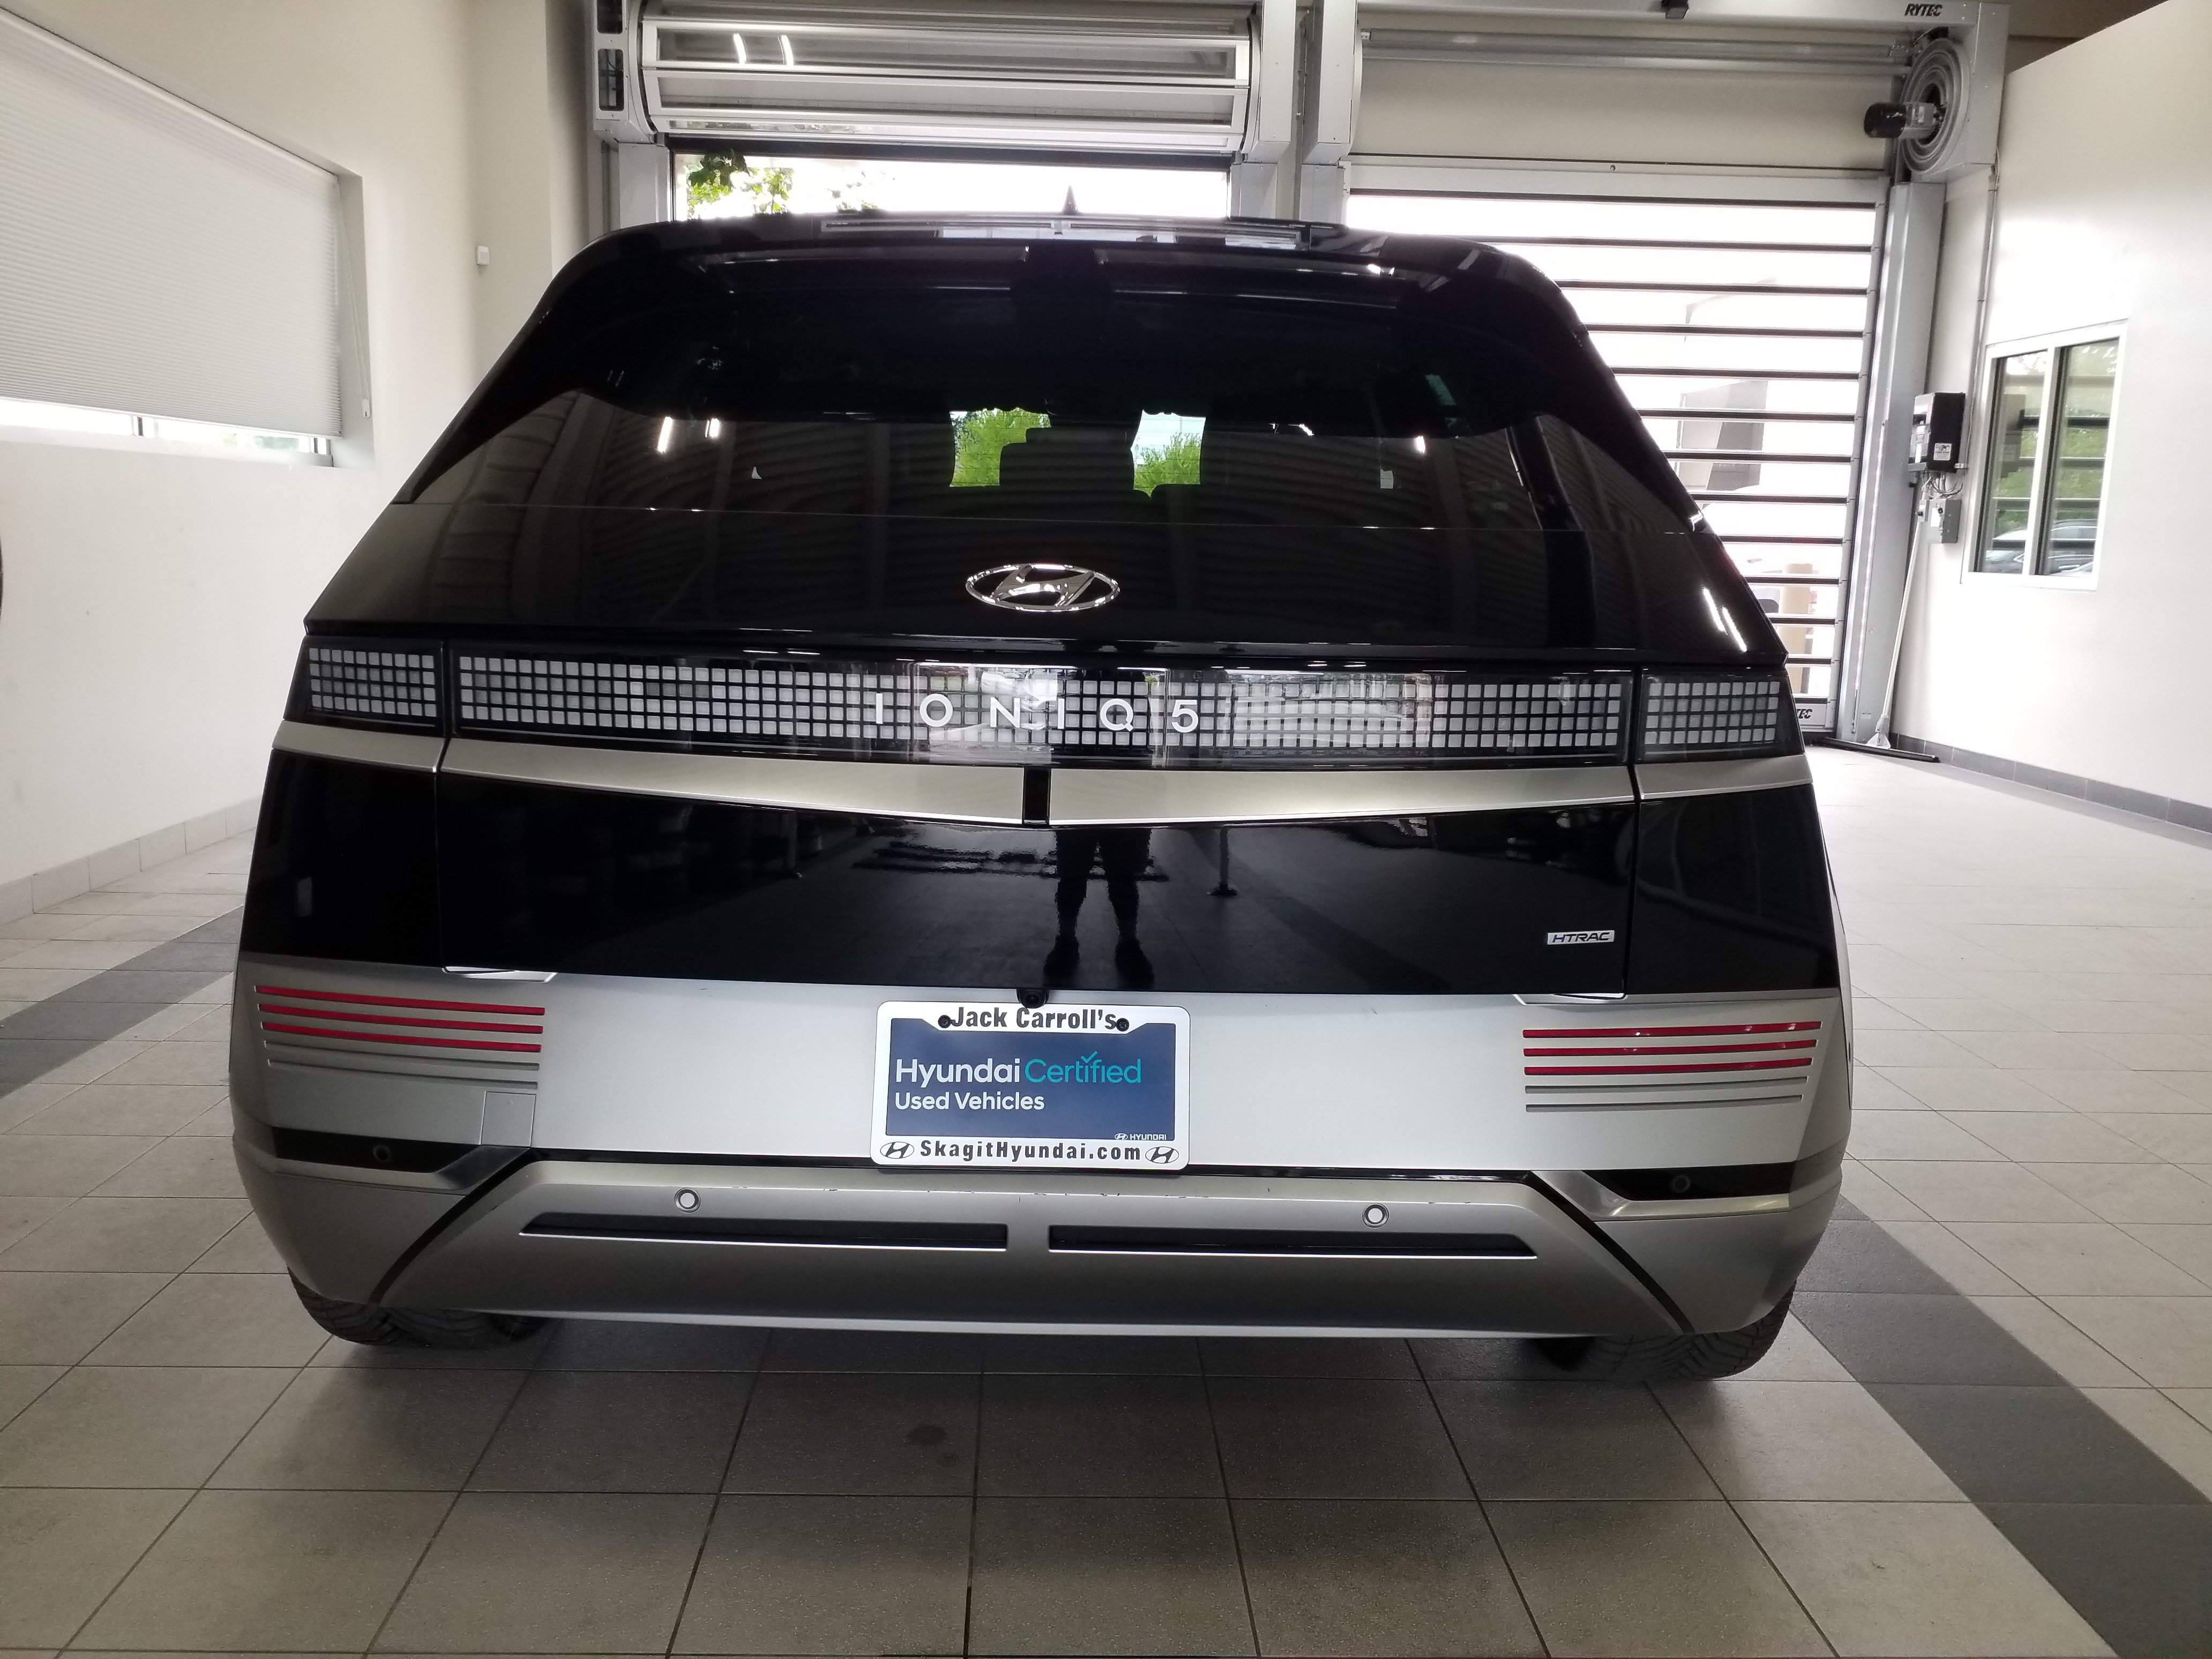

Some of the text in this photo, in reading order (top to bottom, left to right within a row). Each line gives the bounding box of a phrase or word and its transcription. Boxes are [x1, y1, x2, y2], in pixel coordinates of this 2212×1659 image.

[1904, 3, 1942, 16] RYTEC
[1552, 932, 1610, 943] HTRAC
[951, 1007, 1117, 1030] Jack Carroll's
[896, 1051, 1141, 1088] Hyundai Certified
[895, 1091, 1045, 1110] Used Vehicles
[920, 1140, 1141, 1162] SkagitHyundai.com
